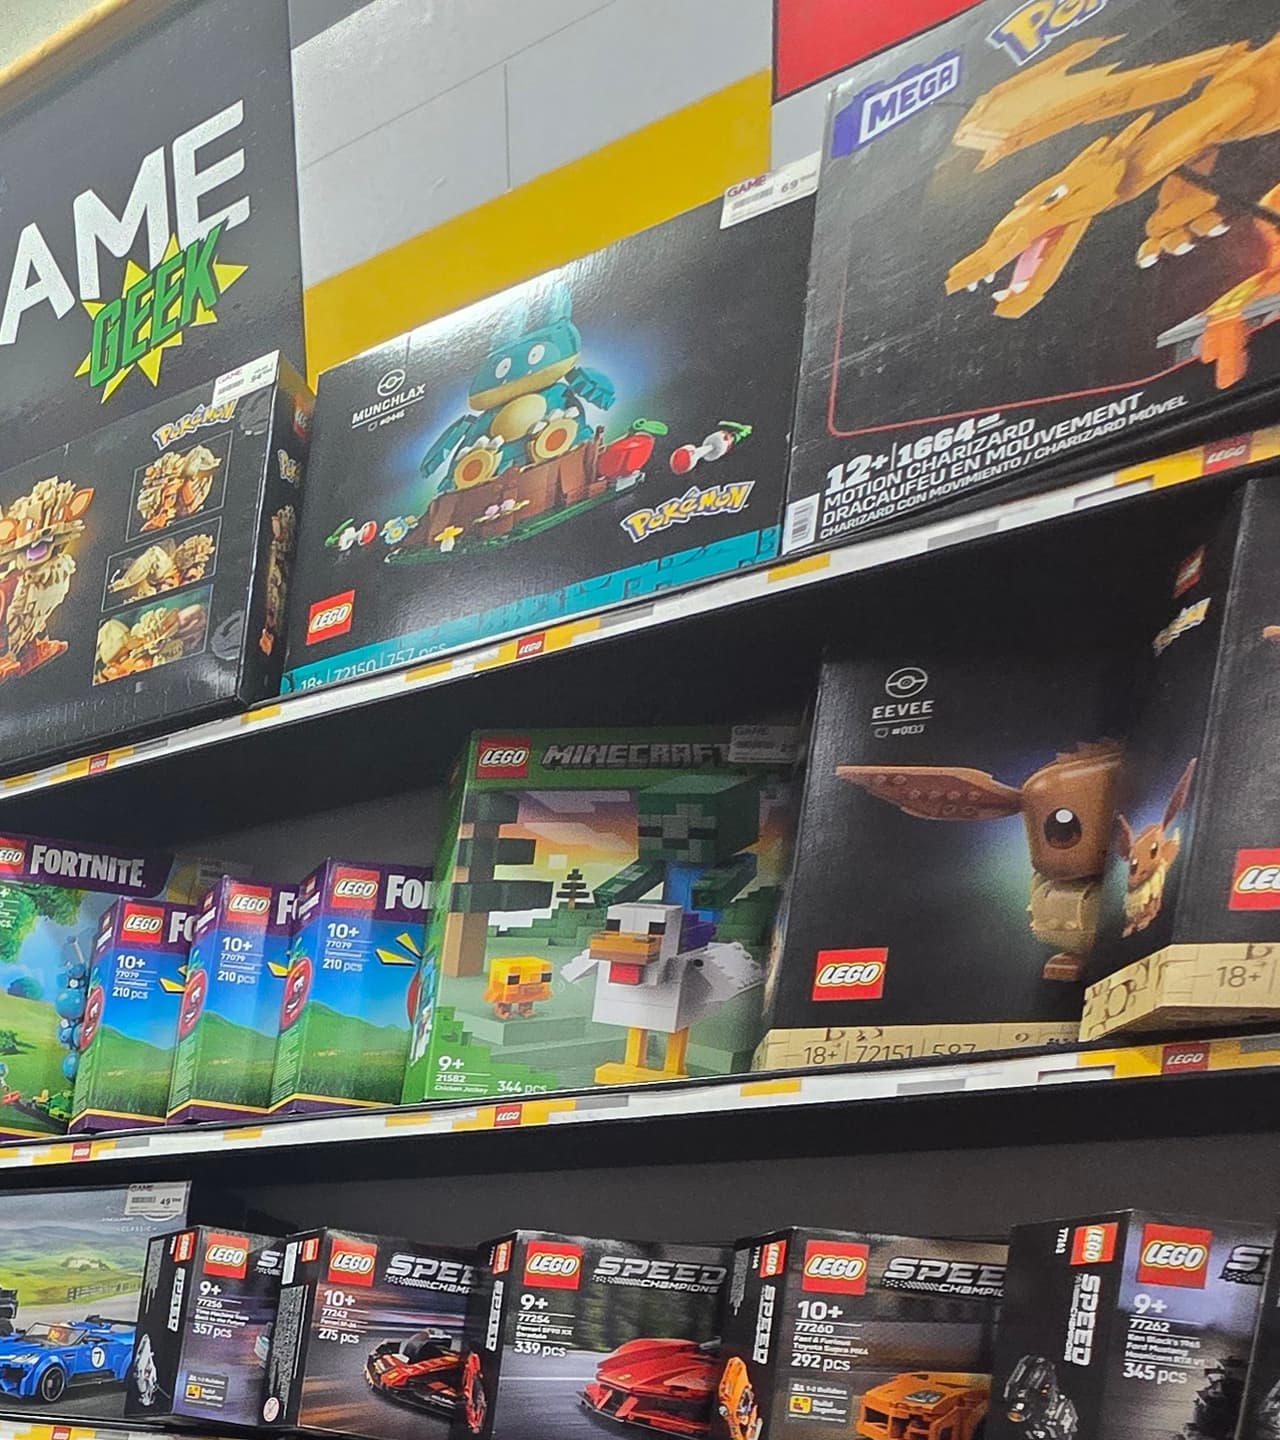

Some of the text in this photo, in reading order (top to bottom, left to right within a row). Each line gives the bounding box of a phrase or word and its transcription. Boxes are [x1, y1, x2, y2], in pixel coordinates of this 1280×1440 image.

[868, 65, 955, 130] MEGA
[89, 224, 228, 388] GEEK
[351, 382, 426, 425] MUNCHLAX
[820, 506, 895, 540] CHARIZARD
[896, 494, 927, 512] CON
[927, 458, 1022, 502] MOVIMIENTO
[1032, 417, 1126, 464] CHARIZARD
[1127, 394, 1189, 425] MÓVEL
[821, 393, 1143, 528] DRACAUFEU EN MOUVEMENT
[823, 418, 1036, 511] MOTION CHARIZARD
[871, 699, 934, 719] EEVEE
[478, 742, 732, 770] LEGO MINECRAFT
[29, 844, 143, 888] FORTNITE
[327, 922, 359, 939] 10+
[1217, 965, 1261, 988] 18+
[112, 986, 148, 1000] 210 pcs
[803, 1042, 915, 1065] 18+ 72151
[435, 1073, 466, 1084] 21582
[497, 1079, 521, 1094] 344
[526, 1255, 727, 1284] LEGO SPEED
[199, 1280, 223, 1297] 9+
[640, 1279, 719, 1294] CHAMPIONS
[797, 1300, 844, 1321] 10+
[794, 1322, 835, 1335] 77260
[1129, 1319, 1170, 1334] 77262
[1123, 1363, 1188, 1386] 345 pcs
